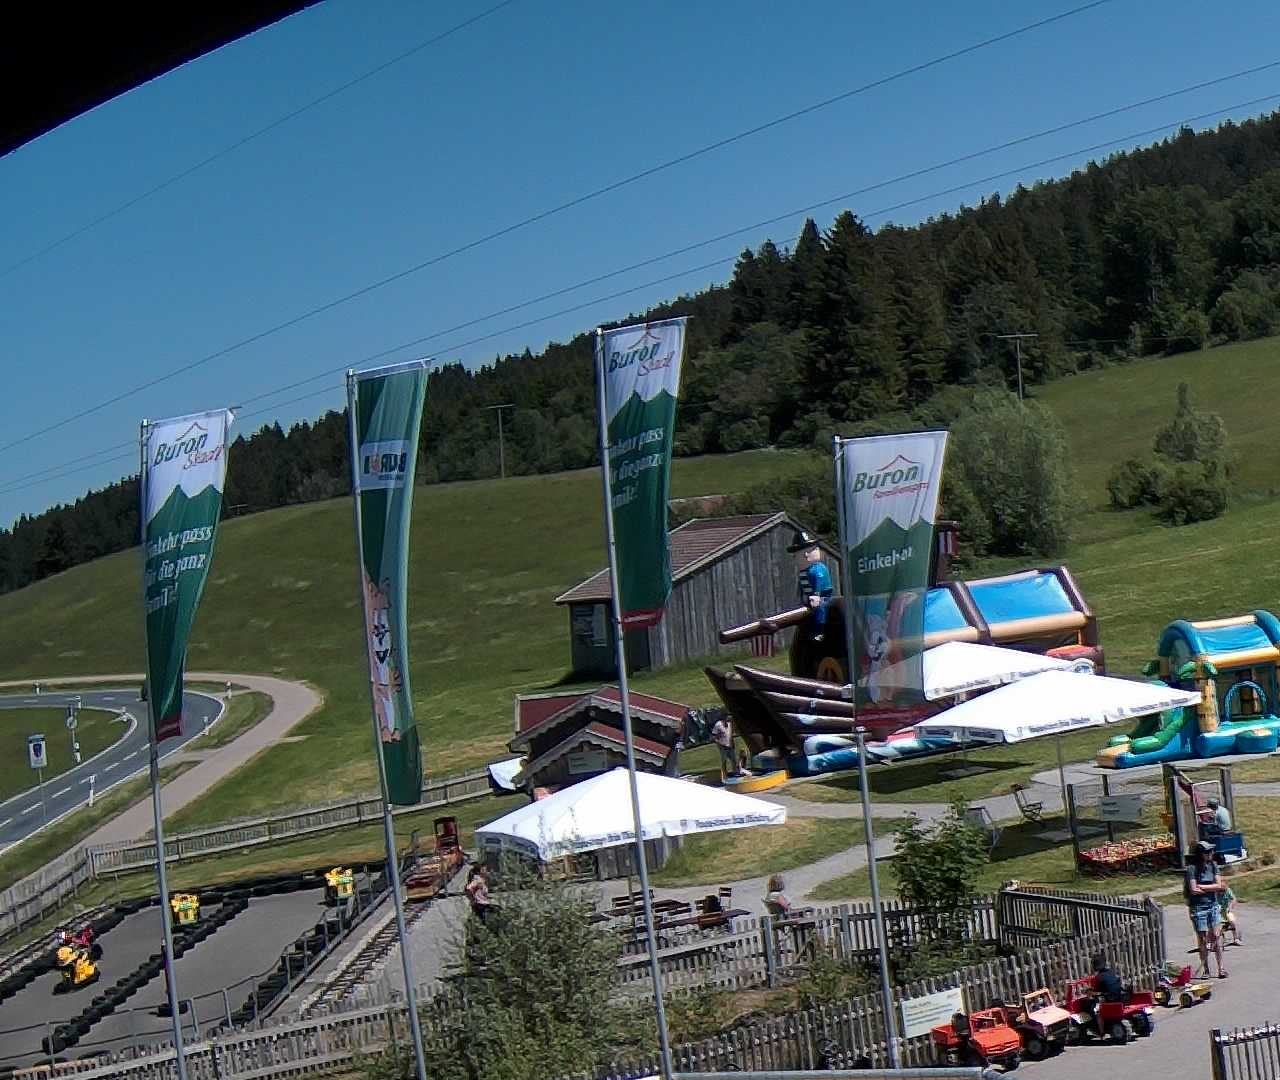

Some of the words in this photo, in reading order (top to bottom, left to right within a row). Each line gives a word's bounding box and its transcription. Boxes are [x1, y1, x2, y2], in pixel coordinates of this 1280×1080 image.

[608, 342, 660, 373] Buron
[154, 433, 208, 467] Buron
[853, 466, 919, 493] Buron
